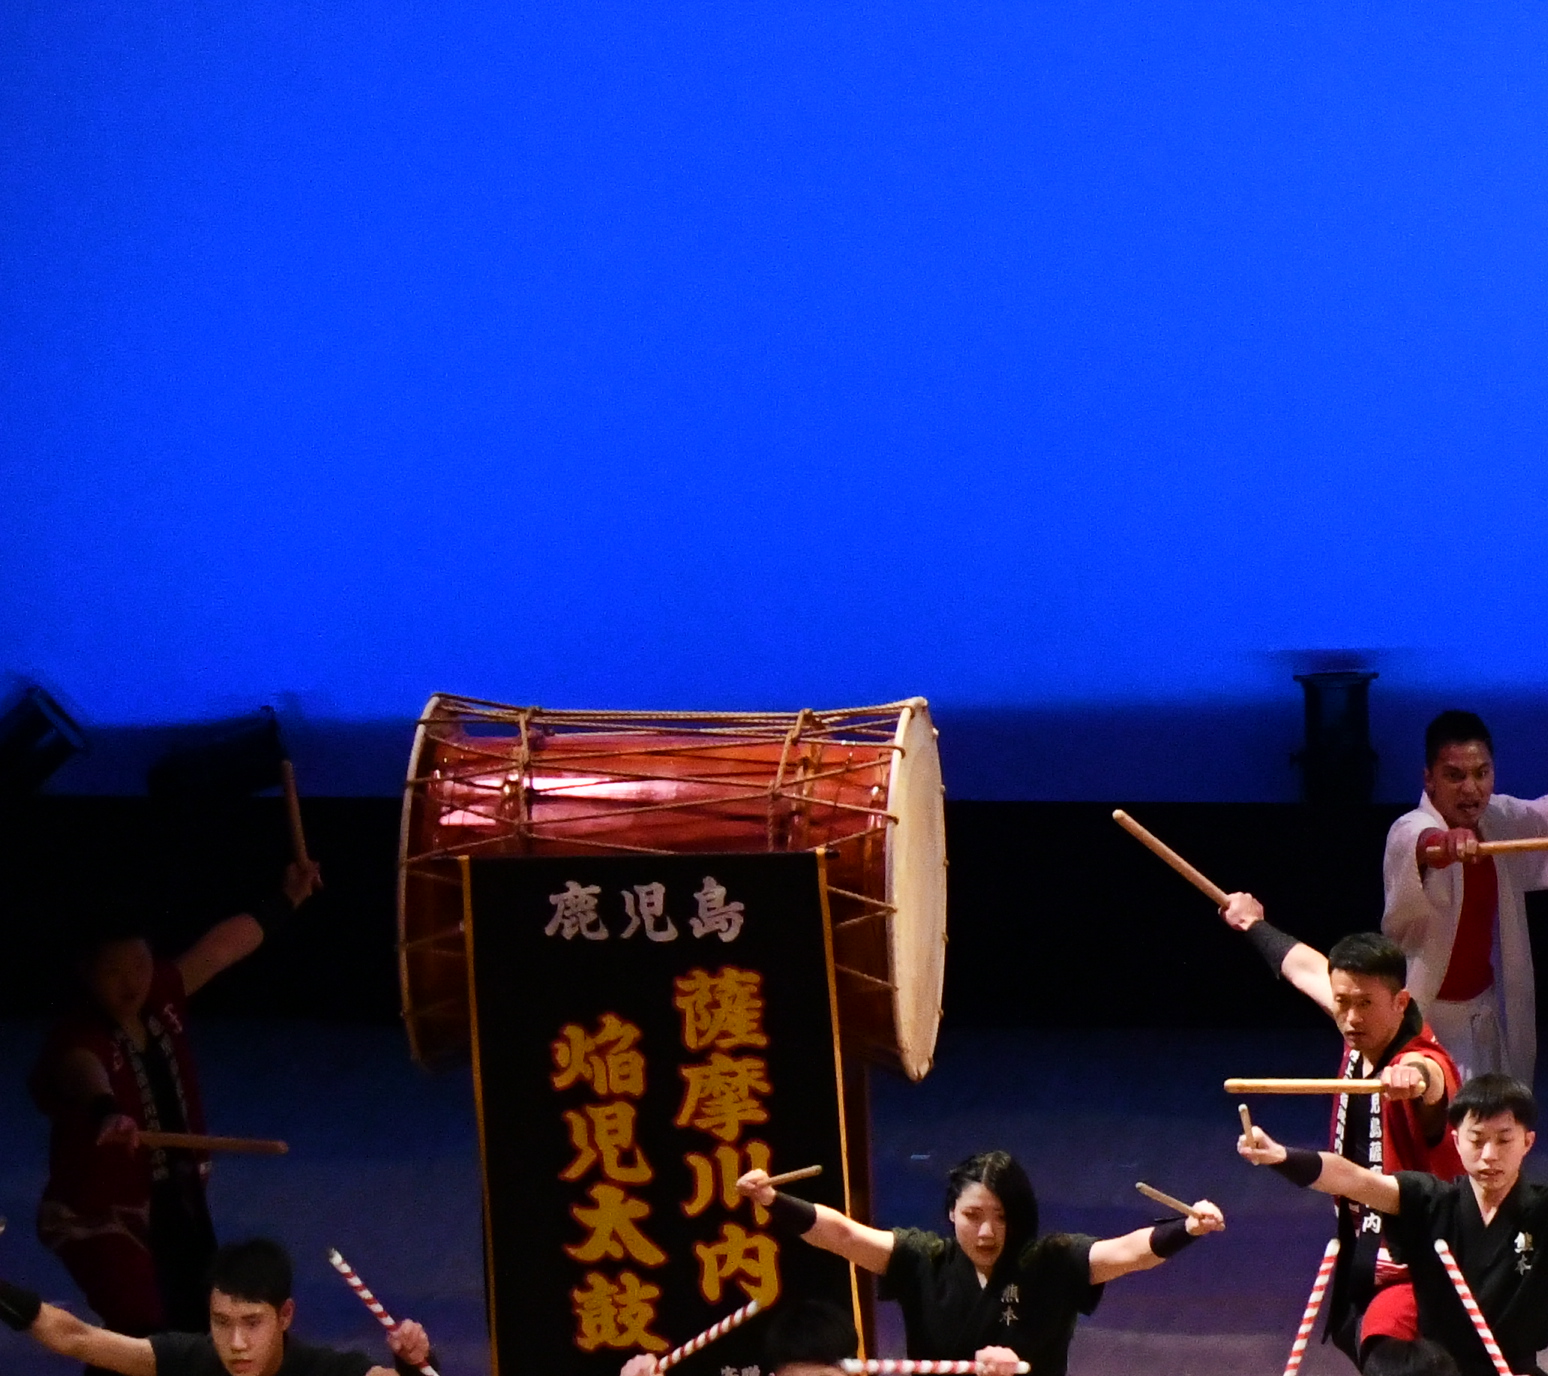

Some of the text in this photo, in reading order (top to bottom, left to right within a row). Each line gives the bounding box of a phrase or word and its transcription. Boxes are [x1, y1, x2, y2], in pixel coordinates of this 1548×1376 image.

[544, 876, 746, 943] 鹿児島
[550, 1013, 671, 1355] 焔児太鼓
[673, 964, 783, 1314] 薩摩川内
